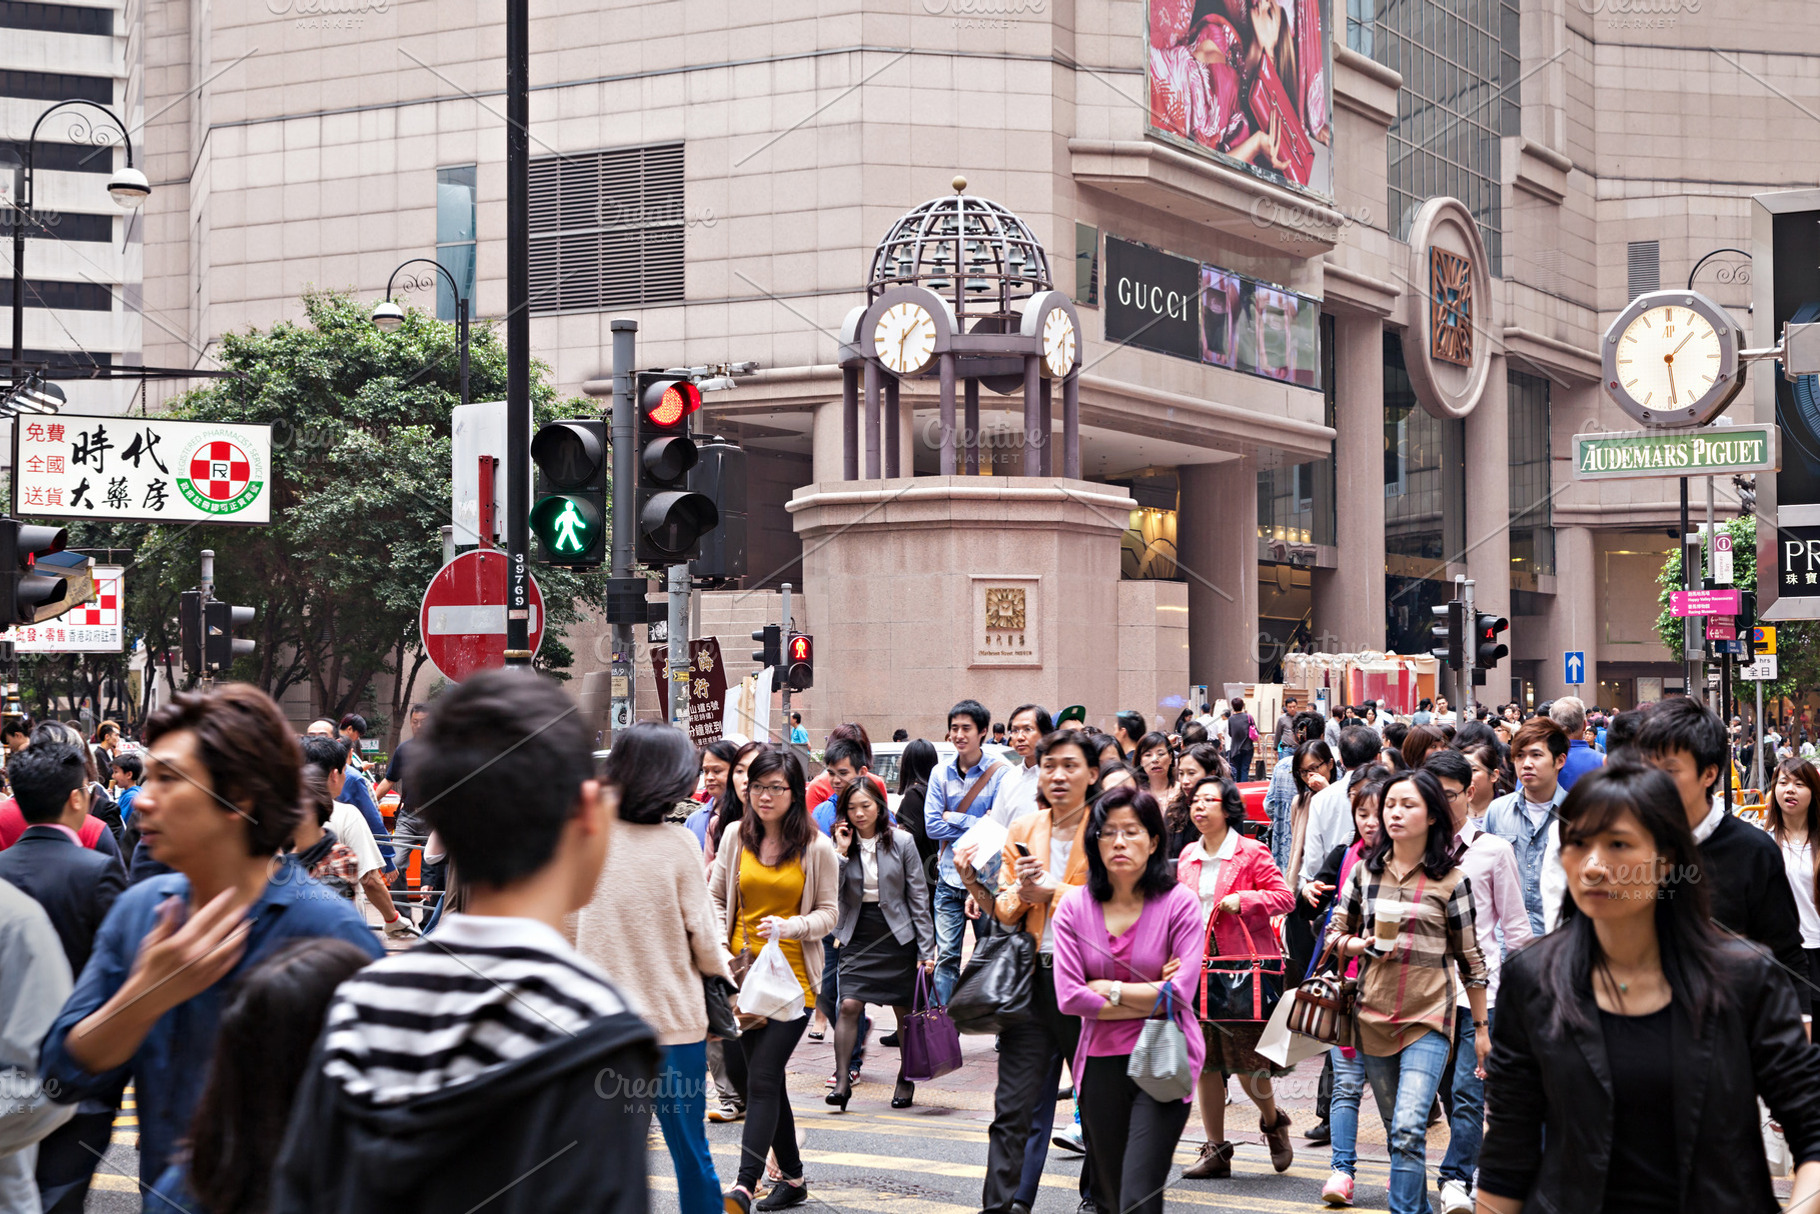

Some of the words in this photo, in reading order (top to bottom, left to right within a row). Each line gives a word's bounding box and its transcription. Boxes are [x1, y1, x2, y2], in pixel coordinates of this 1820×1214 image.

[1118, 277, 1186, 321] GUCCI
[26, 422, 65, 443] 免費
[26, 455, 65, 474] 全國
[71, 424, 169, 475] 時代
[178, 434, 203, 476] REGISTERED
[203, 429, 253, 449] PHARMACIST
[250, 447, 263, 480] SERVICE
[1581, 443, 1688, 471] AUDEMARS
[1691, 439, 1762, 466] PIGUET
[24, 486, 64, 507] 送貨
[70, 476, 169, 512] 大藥房
[1785, 540, 1820, 571] PR
[514, 553, 525, 606] 39769
[1786, 572, 1818, 585] 珠寶
[1748, 667, 1770, 677] 全日
